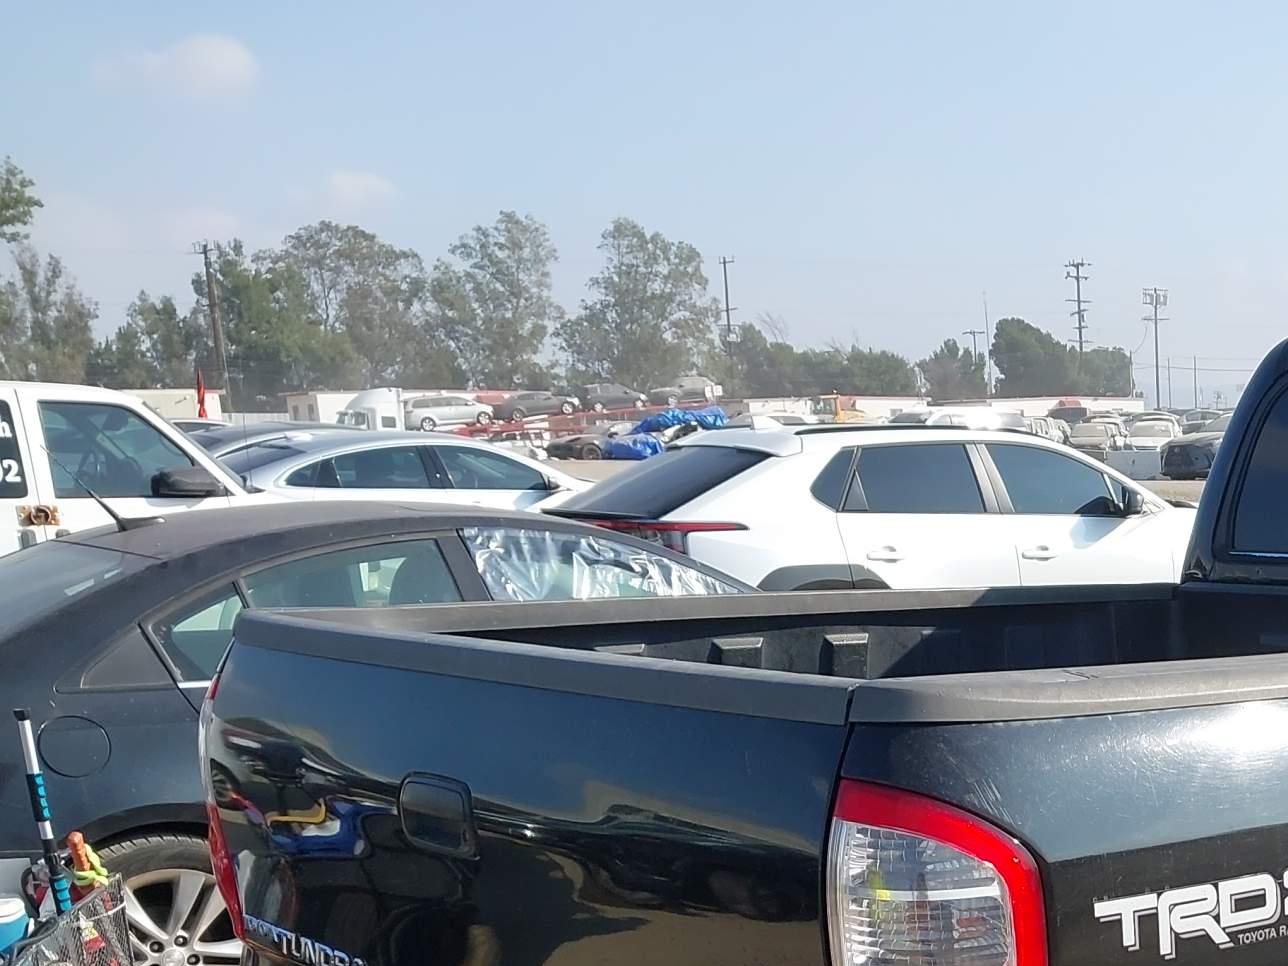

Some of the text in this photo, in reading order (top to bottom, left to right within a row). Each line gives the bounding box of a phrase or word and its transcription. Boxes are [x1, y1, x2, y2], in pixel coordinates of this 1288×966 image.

[0, 459, 21, 482] 2
[1094, 873, 1282, 960] TRD
[1237, 927, 1277, 945] TOYOTA
